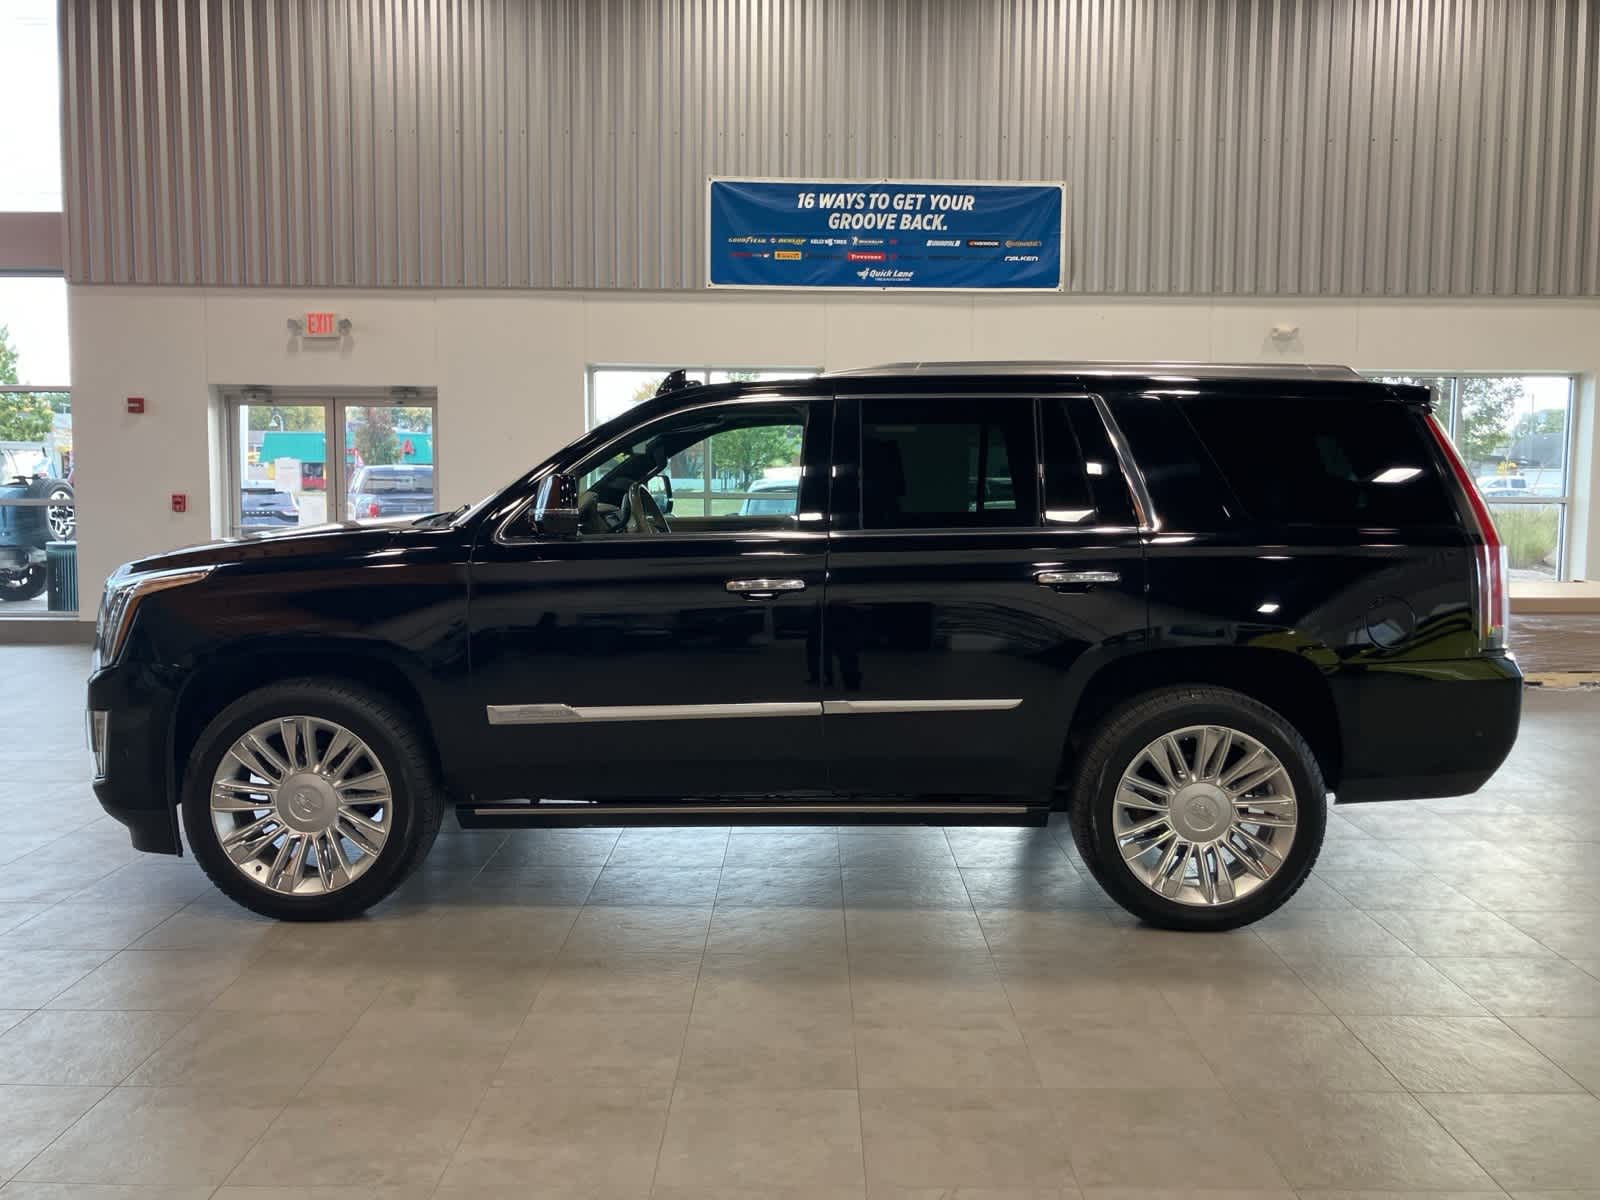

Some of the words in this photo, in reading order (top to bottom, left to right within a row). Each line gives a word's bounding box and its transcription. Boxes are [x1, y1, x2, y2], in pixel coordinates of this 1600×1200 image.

[797, 193, 815, 209] 16
[819, 193, 866, 210] WAYS
[869, 193, 890, 210] TO
[893, 194, 926, 210] GET
[930, 194, 976, 211] YOUR
[828, 212, 898, 230] GROOVE
[899, 213, 948, 231] BACK.
[869, 270, 893, 278] Quick
[893, 270, 914, 278] Lane
[306, 312, 335, 336] EXIT
